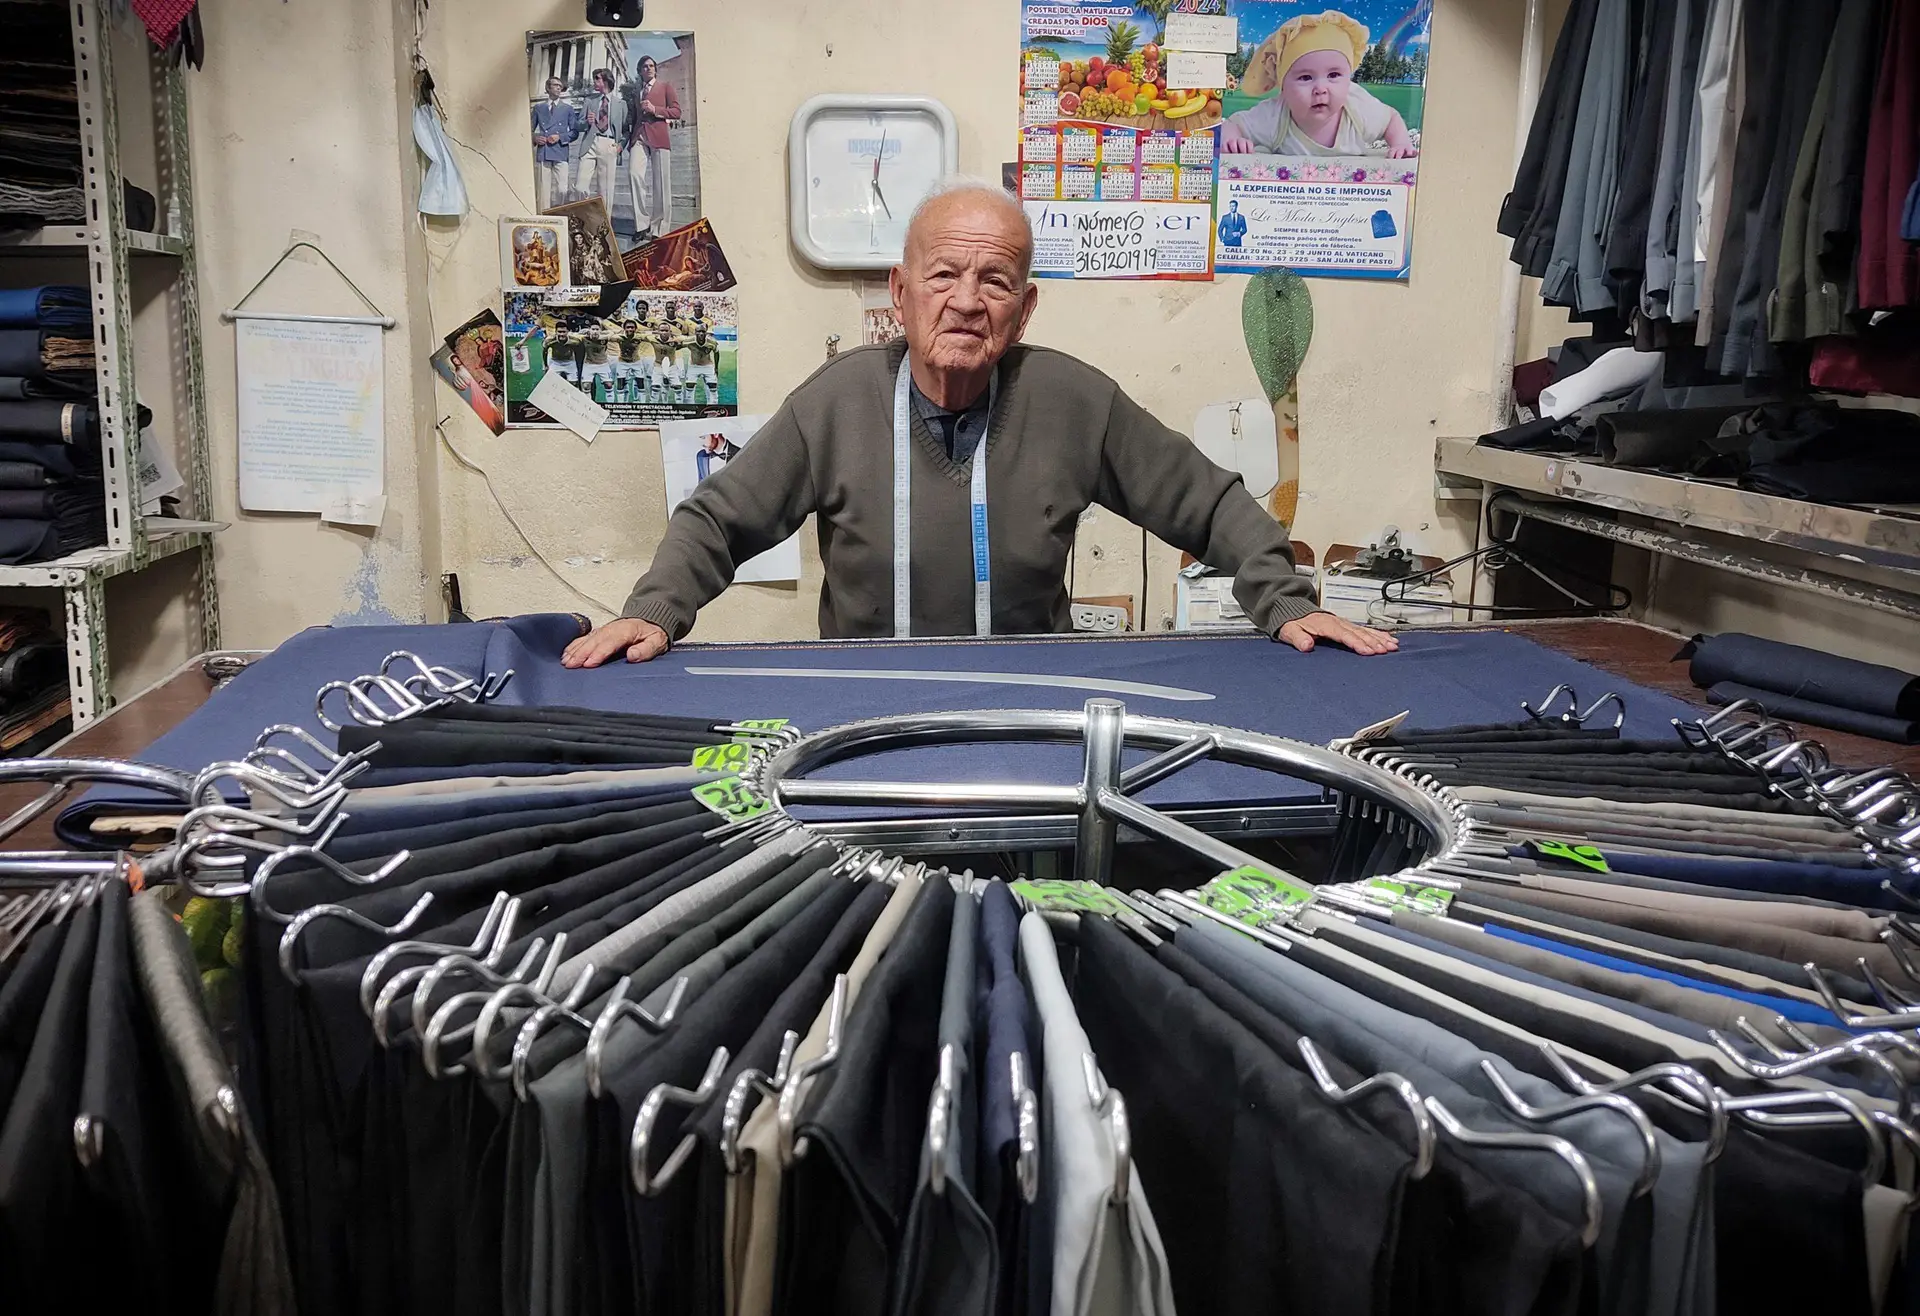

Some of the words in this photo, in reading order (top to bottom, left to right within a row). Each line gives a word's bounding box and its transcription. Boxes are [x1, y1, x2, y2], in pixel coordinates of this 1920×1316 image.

[1028, 6, 1057, 14] POSTRE
[1083, 7, 1132, 15] NATURALEZA
[1175, 0, 1220, 13] 2024
[1082, 17, 1108, 26] DIOS
[812, 177, 821, 188] 9
[1244, 184, 1305, 194] EXPERIENCIA
[1324, 187, 1337, 195] SE
[1339, 188, 1392, 196] IMPROVISA
